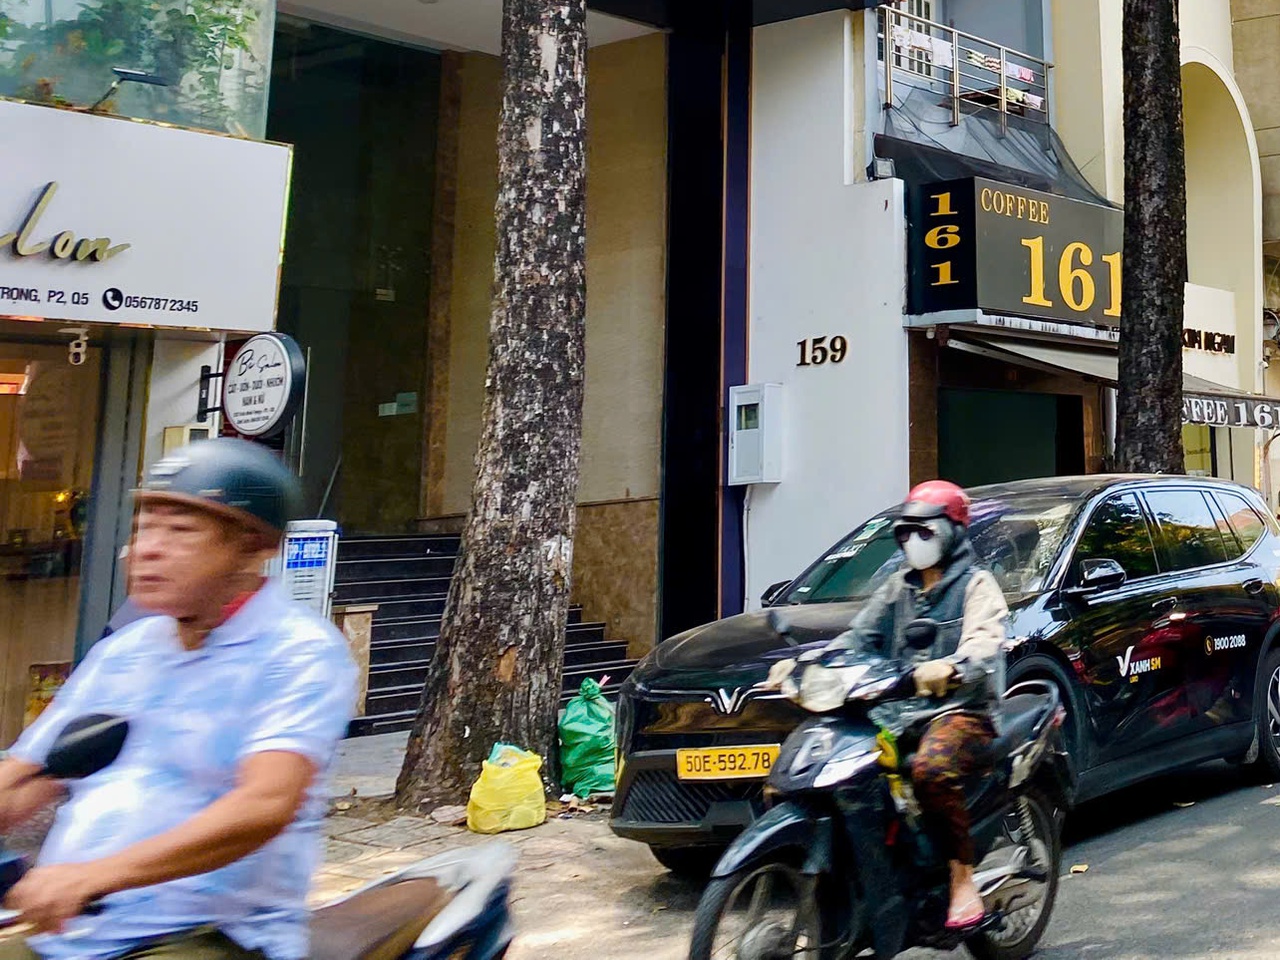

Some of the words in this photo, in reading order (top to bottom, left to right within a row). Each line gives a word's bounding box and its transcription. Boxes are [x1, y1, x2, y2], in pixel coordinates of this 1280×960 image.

[981, 187, 1049, 225] COFFEE
[1020, 235, 1123, 317] 161
[71, 291, 89, 305] Q5
[124, 295, 199, 313] 0567872345
[796, 335, 848, 367] 159
[1213, 636, 1229, 651] 1900
[1129, 659, 1151, 676] XANH
[1150, 656, 1161, 671] SM
[685, 751, 772, 773] 50E-592.78
